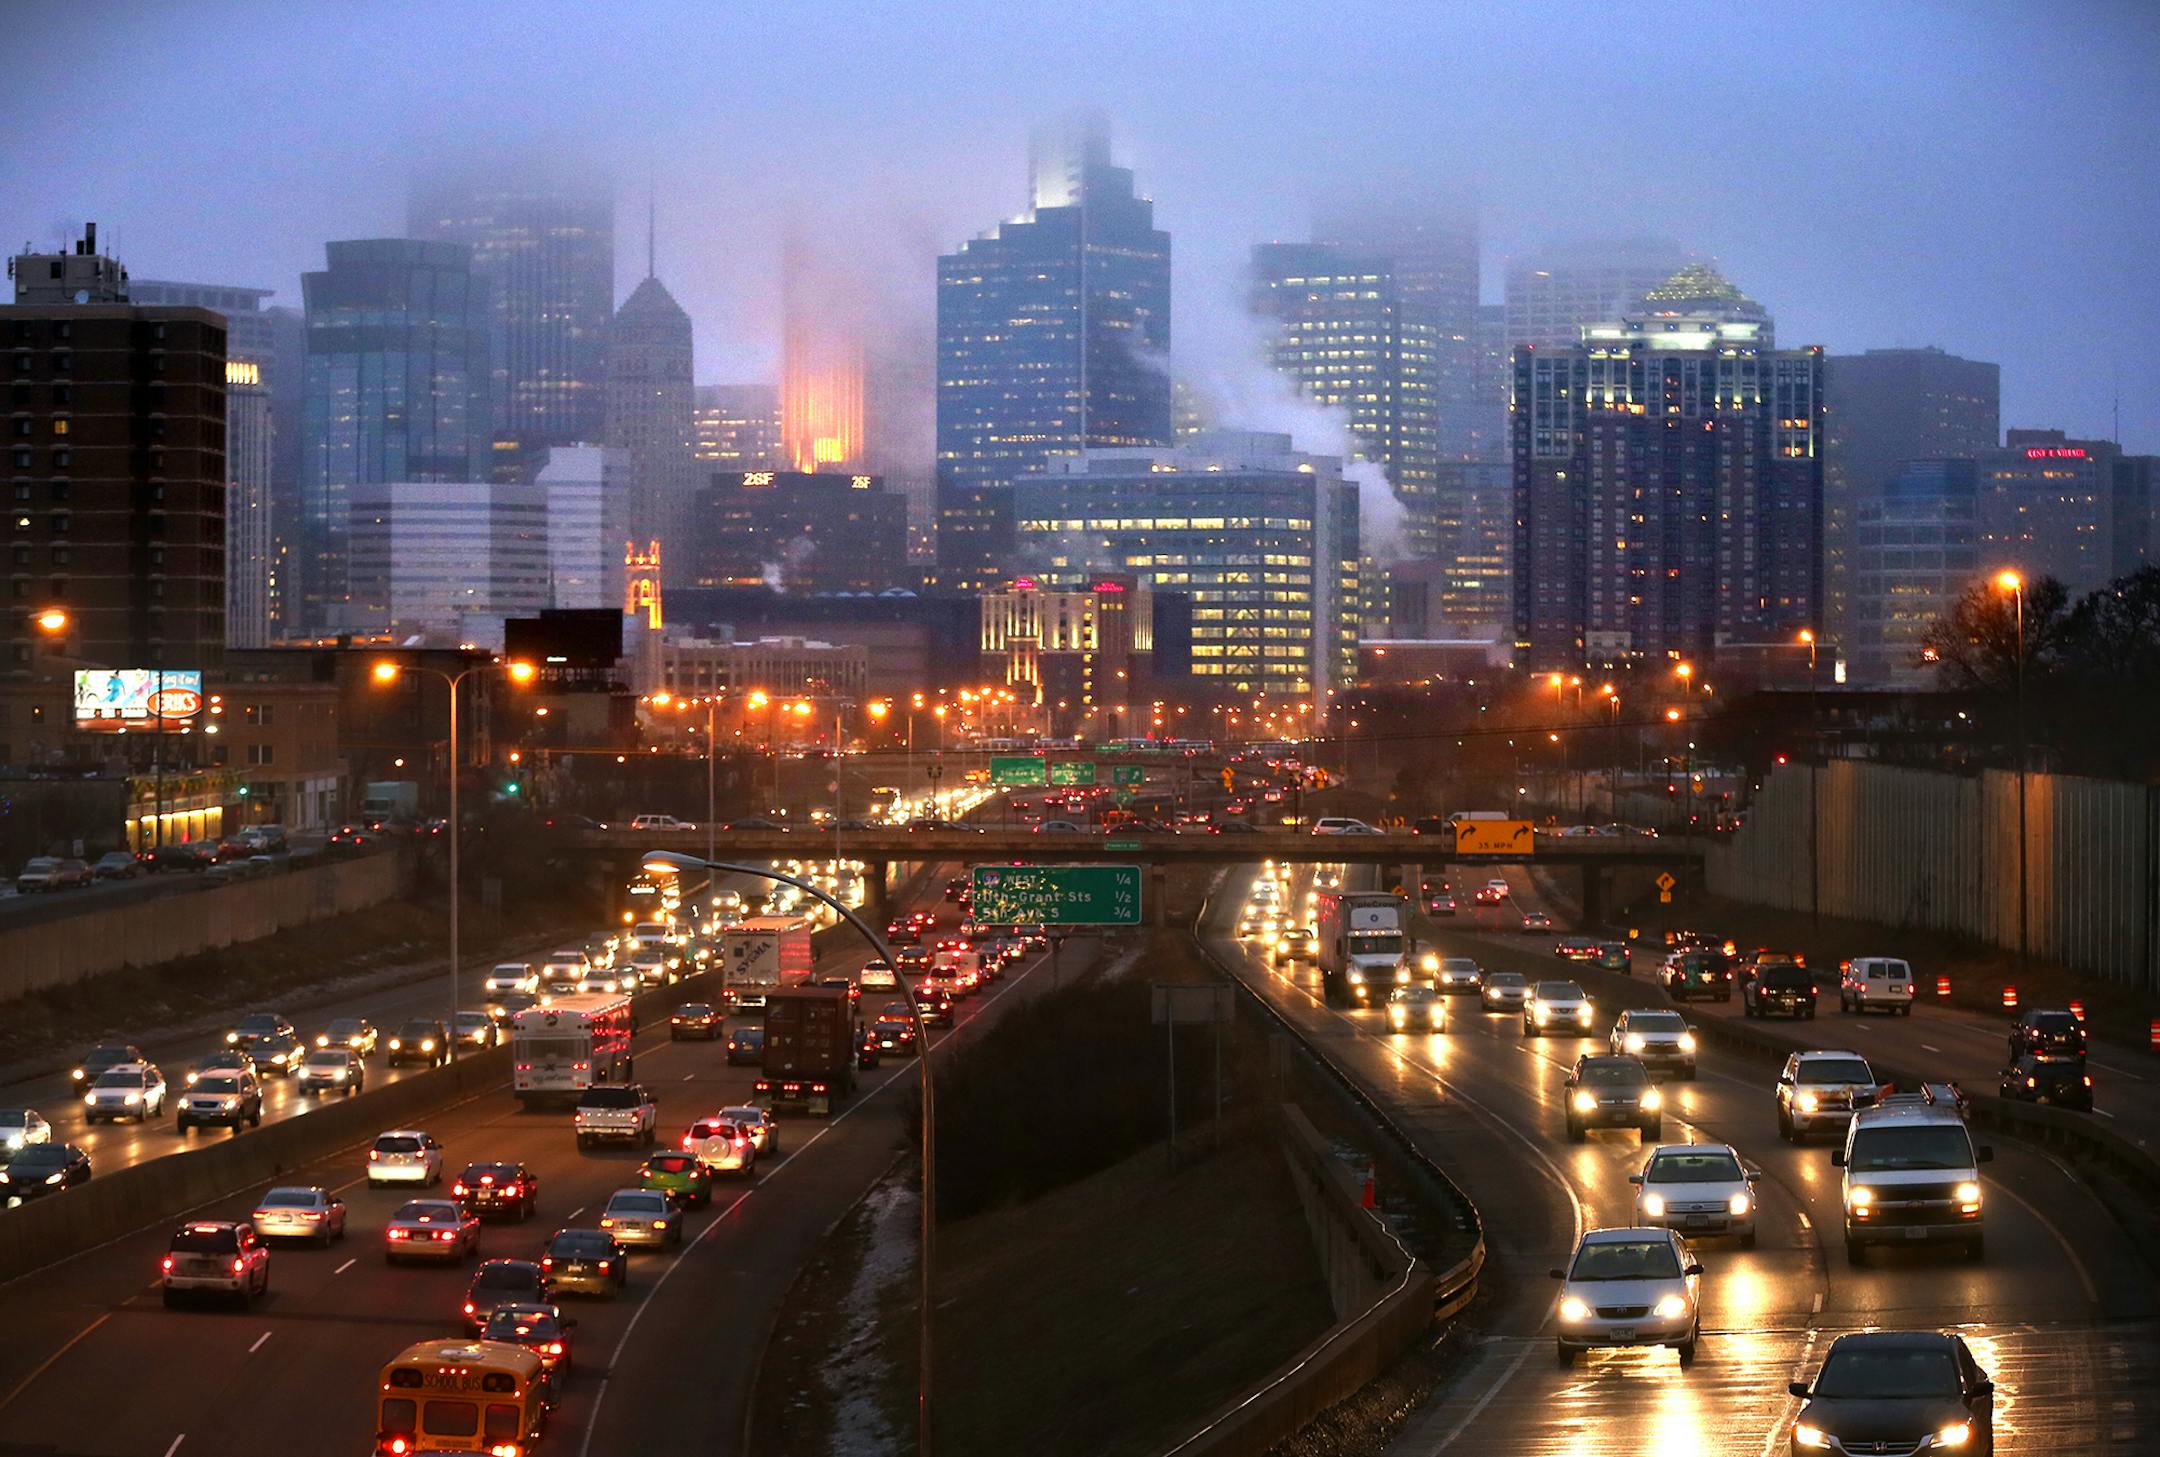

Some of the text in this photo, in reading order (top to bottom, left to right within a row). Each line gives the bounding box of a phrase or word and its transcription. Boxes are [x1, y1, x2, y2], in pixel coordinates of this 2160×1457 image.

[1006, 874, 1037, 884] WEST
[1116, 873, 1131, 885] 1/4
[1068, 891, 1091, 902] Sts
[1115, 891, 1131, 903] 1/2
[982, 907, 1007, 918] 5th
[1051, 907, 1059, 918] S
[1113, 906, 1131, 919] 3/4
[736, 942, 770, 975] SYGMA
[424, 1374, 481, 1391] SCHOOL BUS
